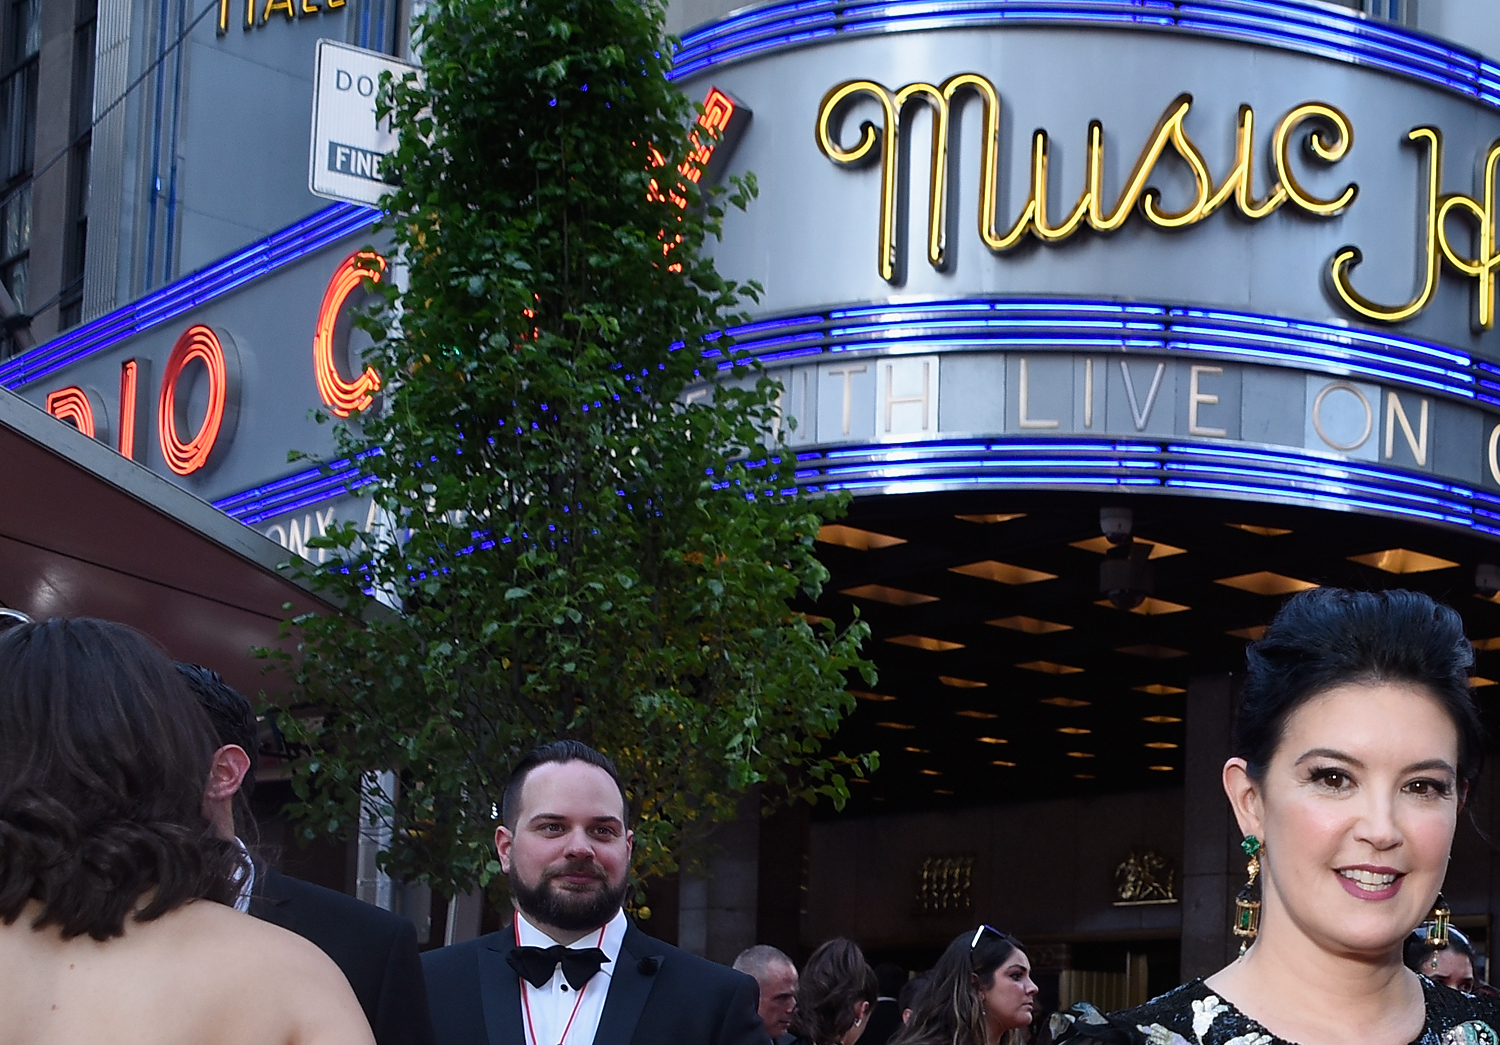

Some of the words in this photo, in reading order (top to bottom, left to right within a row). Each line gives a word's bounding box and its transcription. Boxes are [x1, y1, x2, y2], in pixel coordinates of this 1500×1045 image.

[816, 73, 1360, 283] Music
[1019, 357, 1228, 438] LIVE
[1313, 381, 1429, 467] ON
